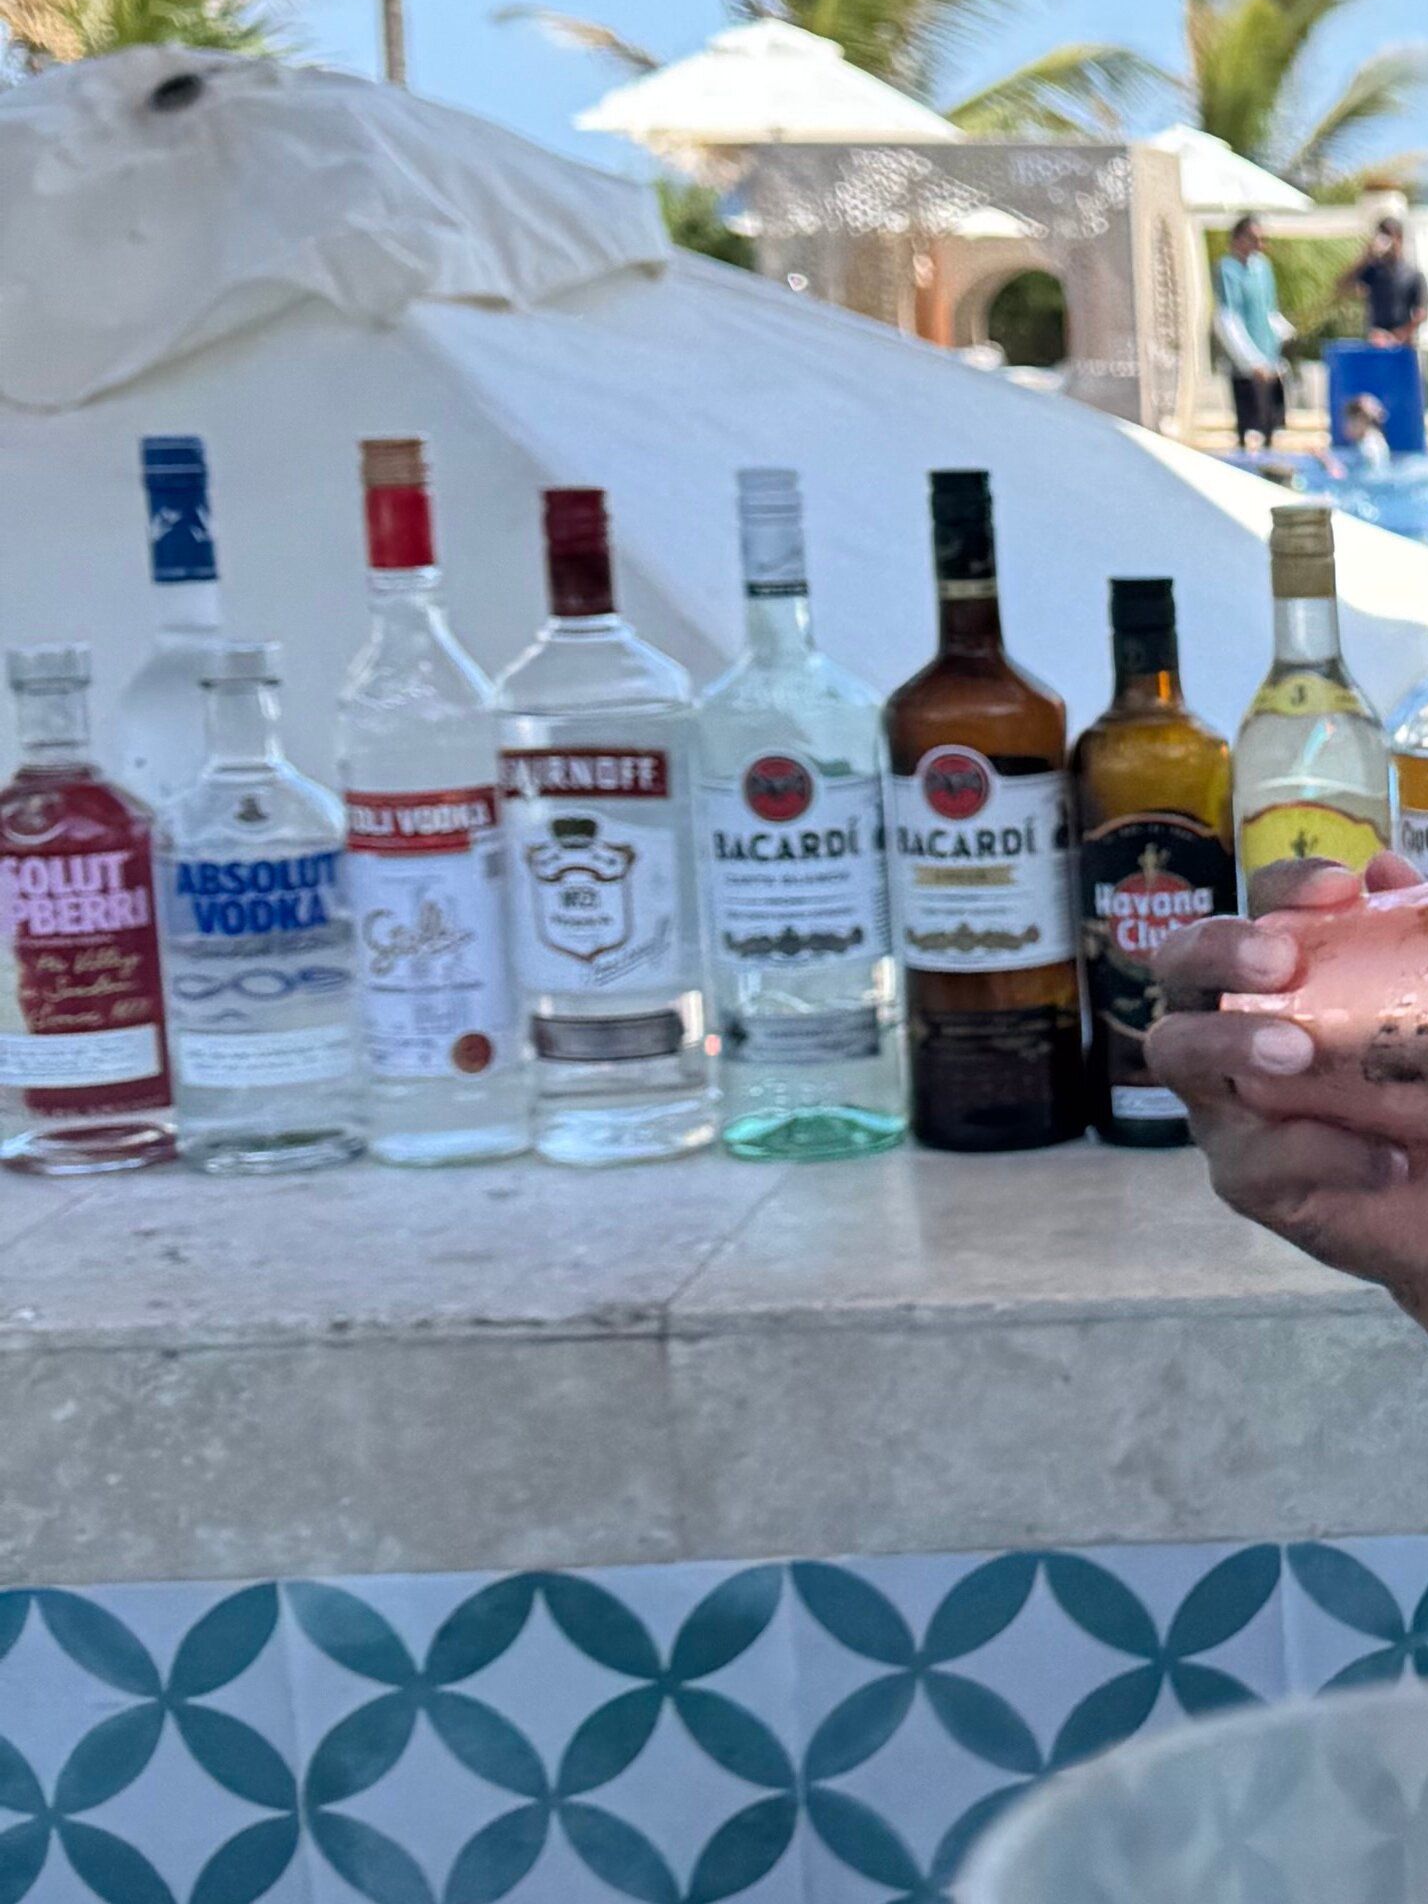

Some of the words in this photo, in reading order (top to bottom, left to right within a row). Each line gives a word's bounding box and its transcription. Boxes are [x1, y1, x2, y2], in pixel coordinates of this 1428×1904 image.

[0, 851, 133, 896] SOLUT
[176, 849, 343, 896] ABSOLUT
[0, 885, 148, 937] PBERRI
[192, 893, 329, 935] VODKA
[1095, 882, 1214, 918] Havana
[1117, 918, 1183, 952] Clu
